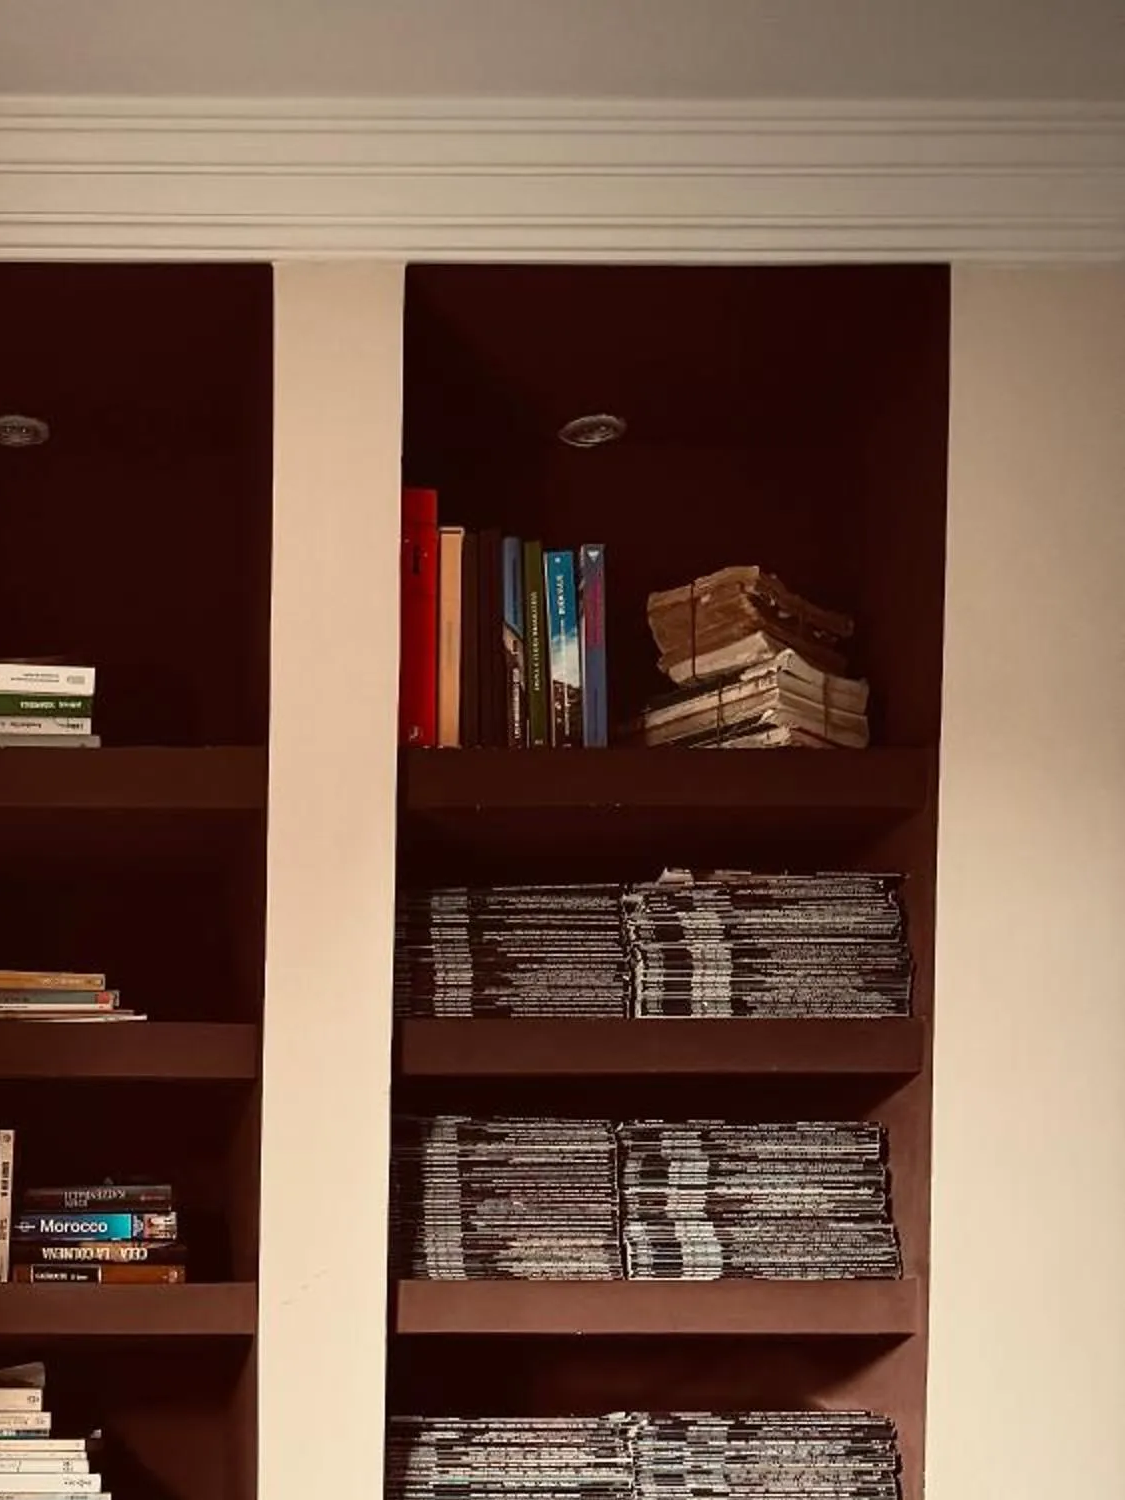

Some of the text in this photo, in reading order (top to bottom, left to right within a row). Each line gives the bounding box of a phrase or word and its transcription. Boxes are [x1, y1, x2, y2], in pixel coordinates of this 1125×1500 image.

[40, 1219, 108, 1233] Morocco
[42, 1247, 148, 1261] CELA LA COLMENA
